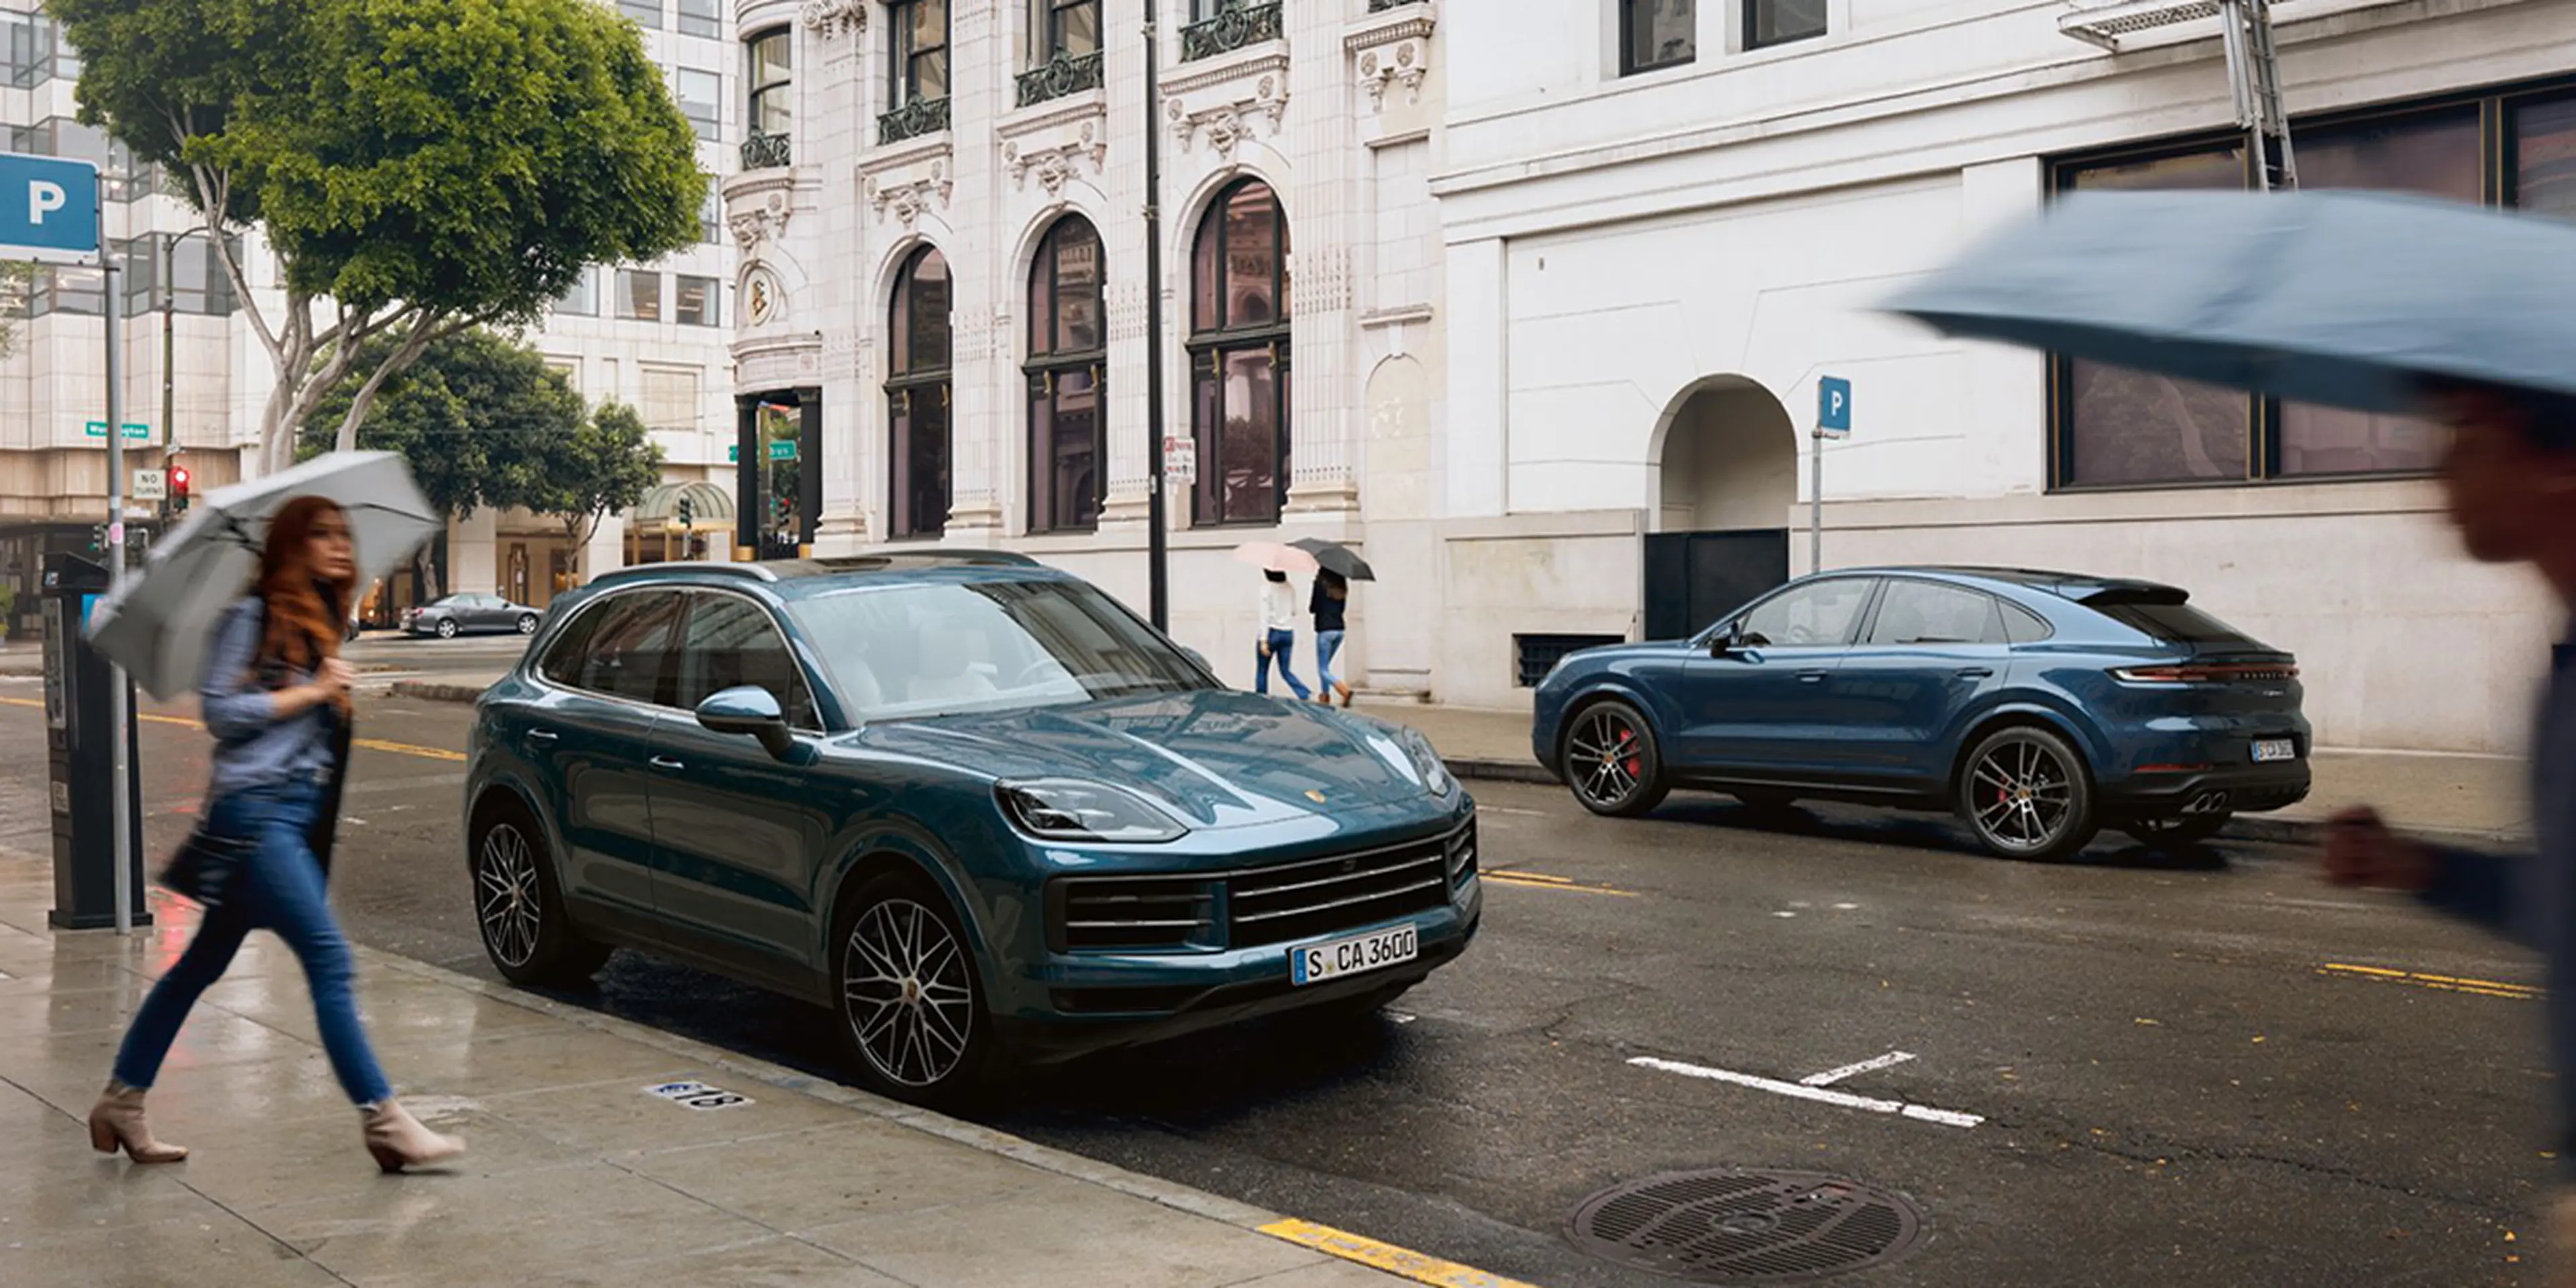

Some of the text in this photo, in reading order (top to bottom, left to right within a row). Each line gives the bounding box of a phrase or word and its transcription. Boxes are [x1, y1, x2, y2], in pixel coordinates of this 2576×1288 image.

[30, 180, 66, 224] P
[1831, 390, 1843, 417] P
[141, 474, 158, 484] NO
[1309, 930, 1414, 977] S CA 3600
[674, 1090, 744, 1107] 18
